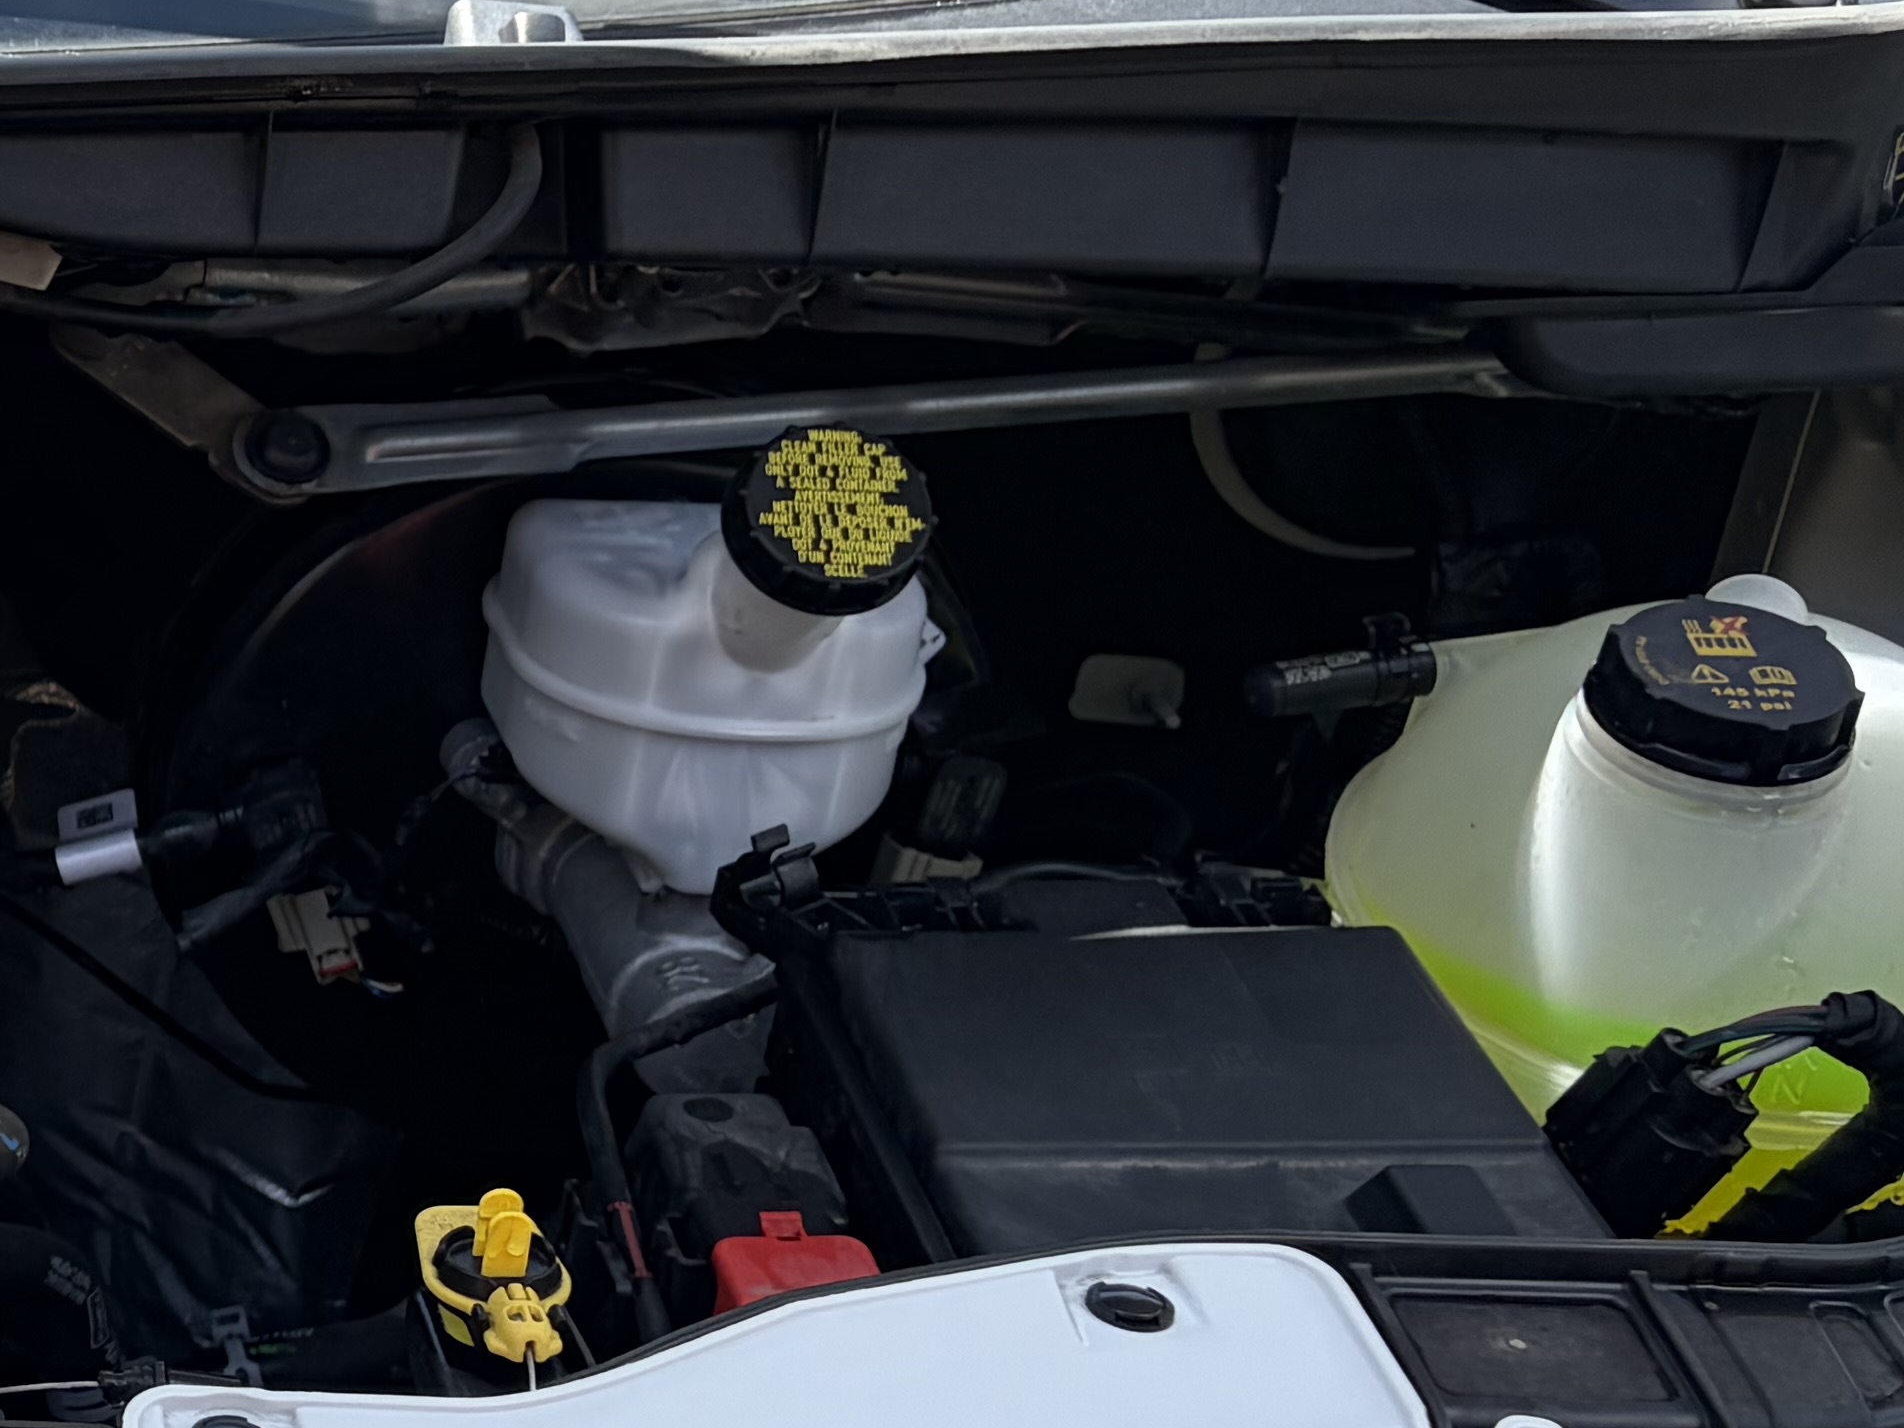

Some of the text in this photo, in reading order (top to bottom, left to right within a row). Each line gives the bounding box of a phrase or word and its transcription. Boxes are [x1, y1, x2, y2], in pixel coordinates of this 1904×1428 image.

[863, 443, 887, 456] CAP
[765, 463, 794, 477] ONLY
[799, 464, 820, 477] DOT
[775, 475, 784, 488] A
[789, 476, 830, 489] SEALED
[759, 511, 793, 525] AVANT
[792, 537, 813, 551] DOT
[1711, 687, 1795, 698] 145 kPa
[1727, 700, 1792, 712] 21 psi
